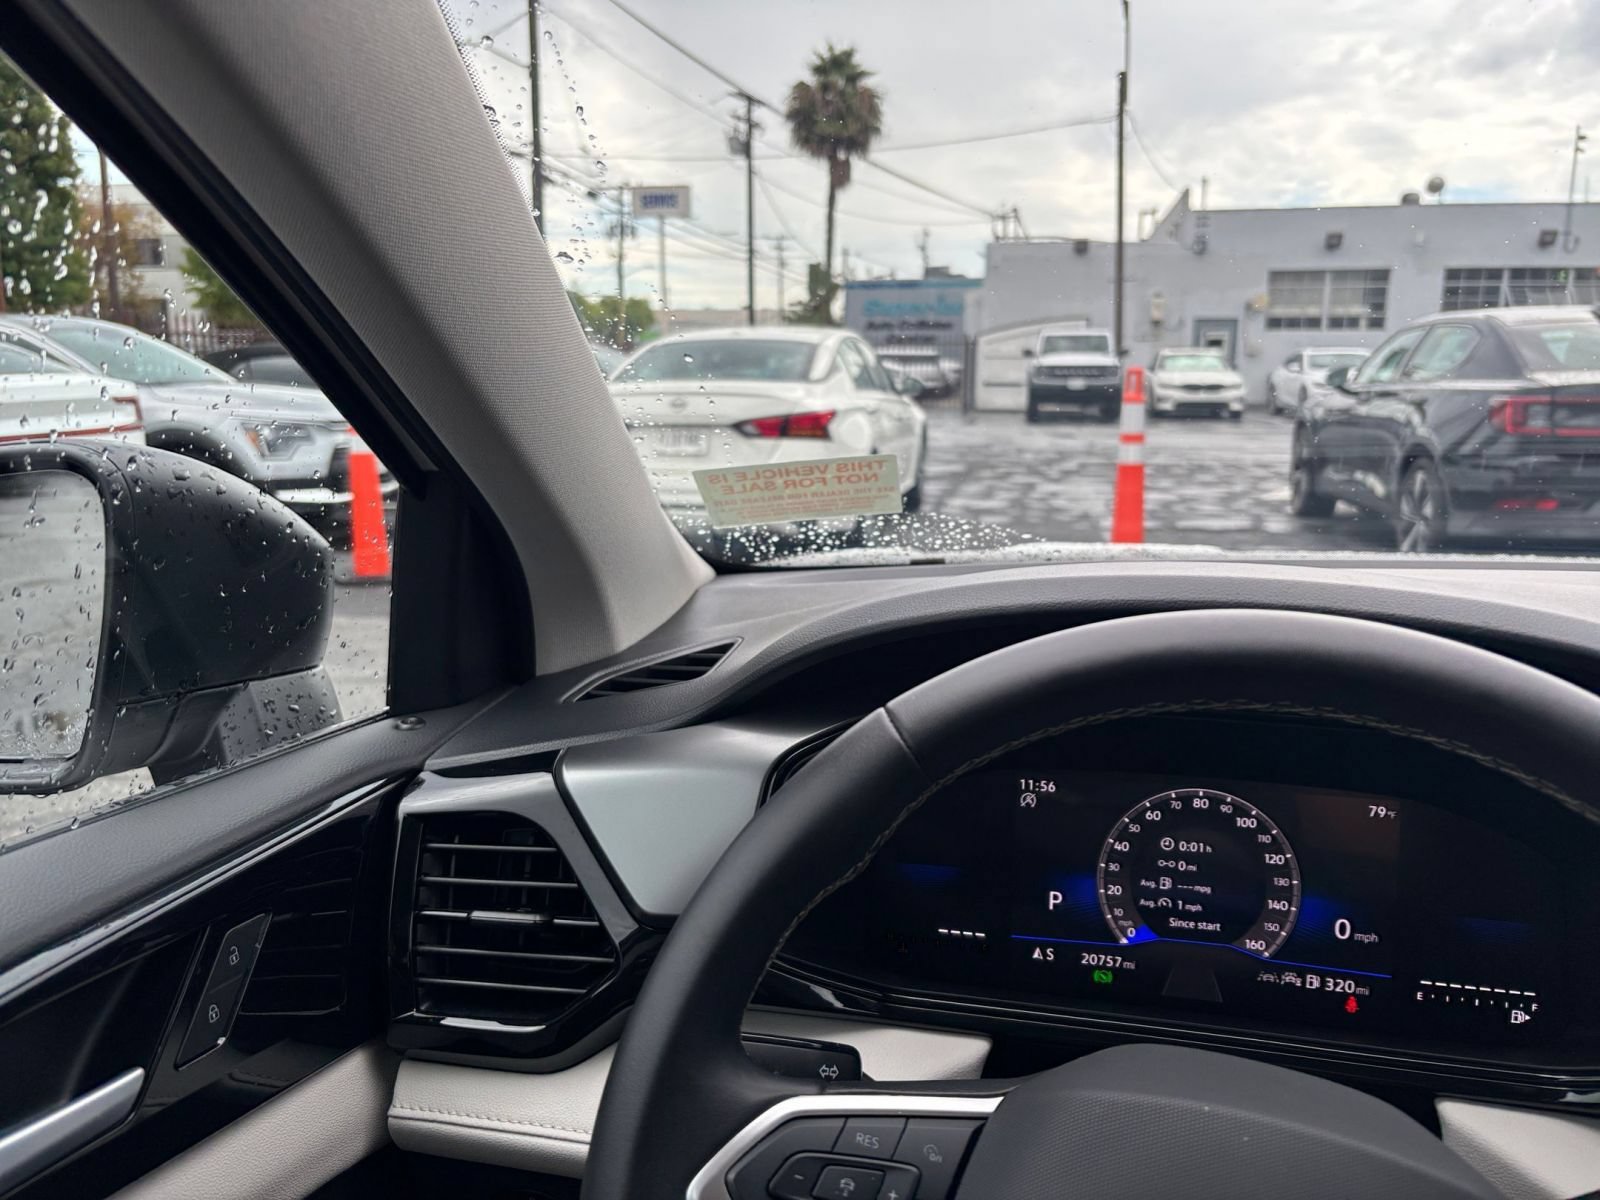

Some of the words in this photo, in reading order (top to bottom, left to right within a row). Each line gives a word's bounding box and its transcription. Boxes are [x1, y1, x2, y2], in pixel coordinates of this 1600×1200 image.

[1019, 778, 1056, 794] 11:56
[1169, 800, 1182, 810] 70
[1192, 797, 1209, 809] 80
[1219, 804, 1233, 814] 90
[1145, 810, 1162, 821] 60
[1235, 815, 1257, 829] 100
[1128, 823, 1141, 834] 50
[1257, 833, 1272, 845] 110
[1113, 841, 1130, 852] 40
[1178, 840, 1204, 853] 0:01
[1206, 845, 1212, 853] h
[1264, 853, 1285, 866] 120
[1107, 861, 1121, 872] 30
[1178, 860, 1187, 871] 0
[1187, 864, 1198, 872] mi
[1140, 879, 1157, 889] Avg.
[1273, 876, 1290, 888] 130
[1106, 884, 1123, 896] 20
[1048, 890, 1064, 911] P
[1139, 898, 1157, 909] Avg.
[1177, 900, 1183, 910] 1
[1184, 903, 1203, 912] mph
[1267, 899, 1289, 912] 140
[1113, 907, 1124, 917] 10
[1169, 917, 1196, 929] Since
[1197, 920, 1221, 932] start
[1263, 921, 1281, 933] 150
[1127, 927, 1136, 938] 0
[1333, 918, 1351, 940] 0
[1353, 931, 1379, 944] mph
[1244, 938, 1266, 951] 160
[1046, 947, 1055, 961] S
[1081, 953, 1122, 968] 20757
[1122, 960, 1136, 970] mi
[1324, 977, 1355, 994] 320
[1355, 986, 1370, 997] mi
[1416, 991, 1424, 1001] E
[1531, 1003, 1539, 1013] F
[855, 1132, 880, 1150] RES
